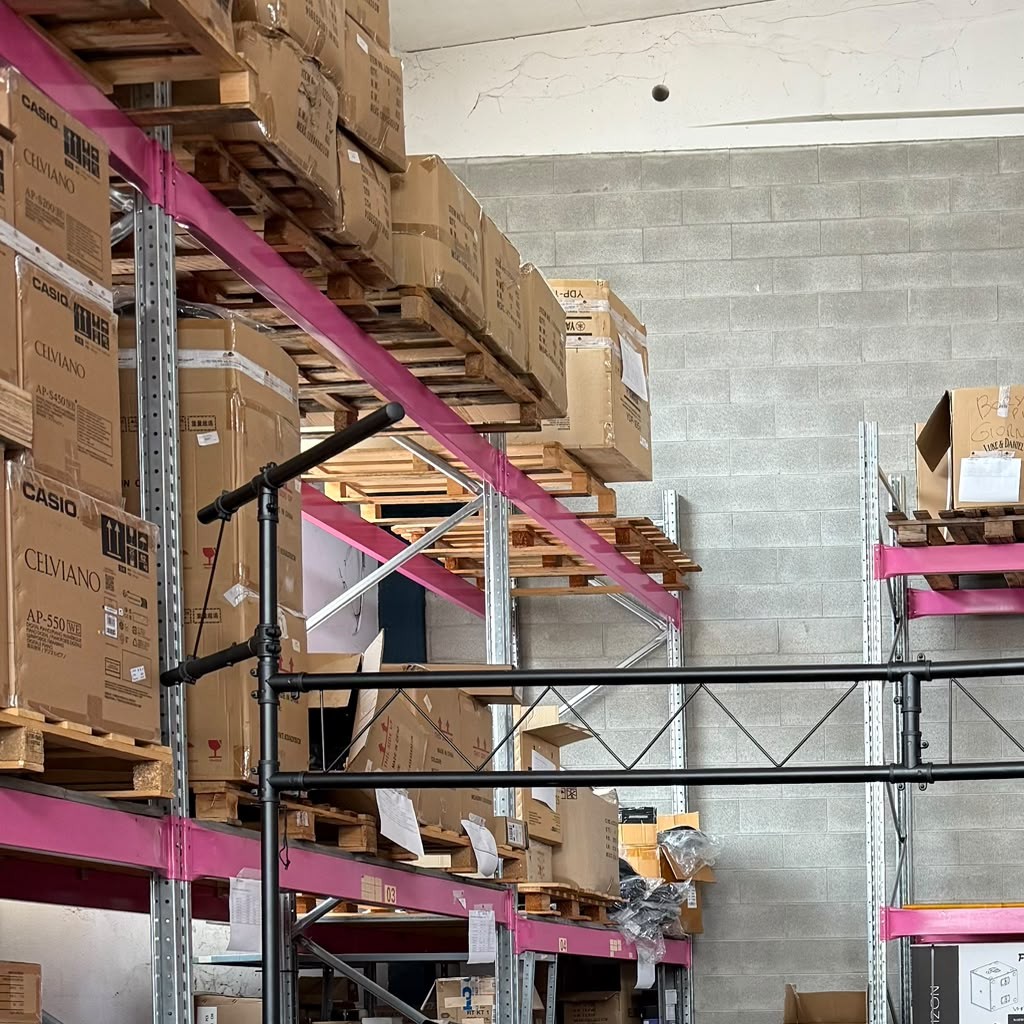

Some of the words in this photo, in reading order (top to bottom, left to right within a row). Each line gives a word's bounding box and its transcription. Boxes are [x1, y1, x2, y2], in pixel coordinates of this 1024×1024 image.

[22, 94, 58, 129] CASIO
[23, 147, 75, 194] CELVIANO
[32, 277, 69, 308] CASIO
[35, 339, 86, 379] CELVIANO
[1004, 438, 1024, 451] DANIEL
[22, 481, 77, 518] CASIO
[24, 548, 101, 593] CELVIANO
[26, 608, 65, 632] AP-550
[386, 887, 396, 903] 03
